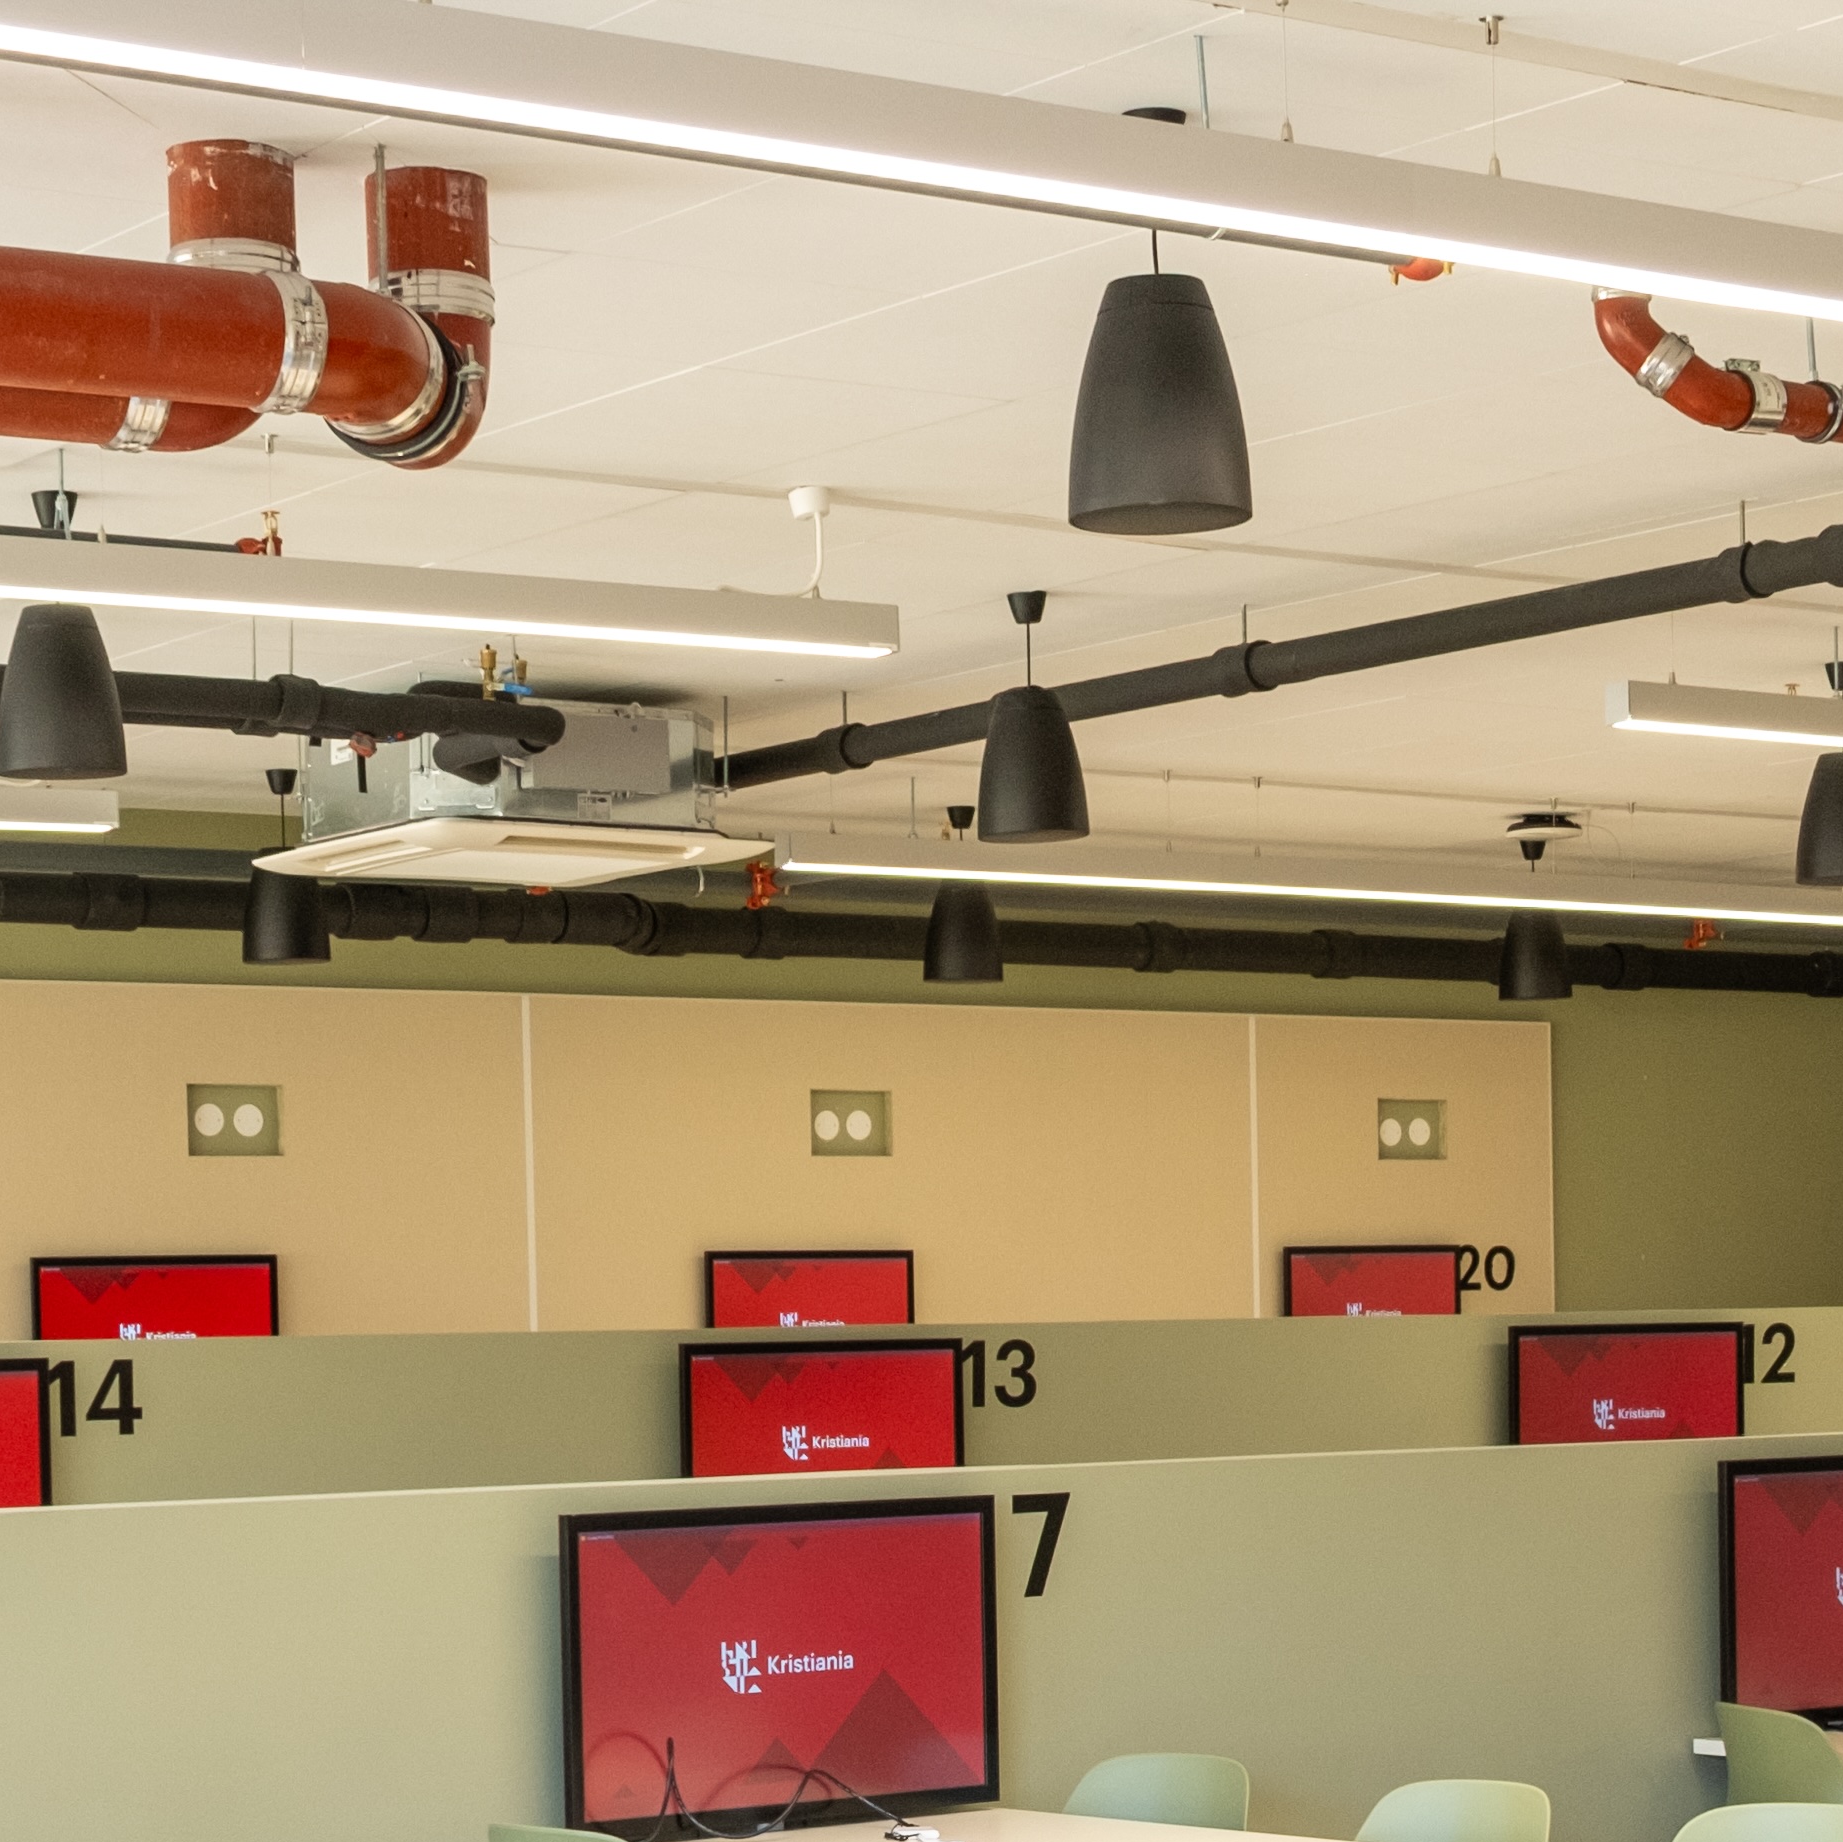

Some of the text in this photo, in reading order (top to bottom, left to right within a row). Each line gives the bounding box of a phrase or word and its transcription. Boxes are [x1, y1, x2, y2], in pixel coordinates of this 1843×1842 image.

[1459, 1244, 1515, 1291] 20
[961, 1338, 1037, 1408] 13
[47, 1359, 143, 1437] 14
[1617, 1406, 1666, 1420] Kristiania
[812, 1434, 870, 1449] Kristiania
[1012, 1492, 1071, 1600] 7
[767, 1650, 854, 1675] Kristiania
